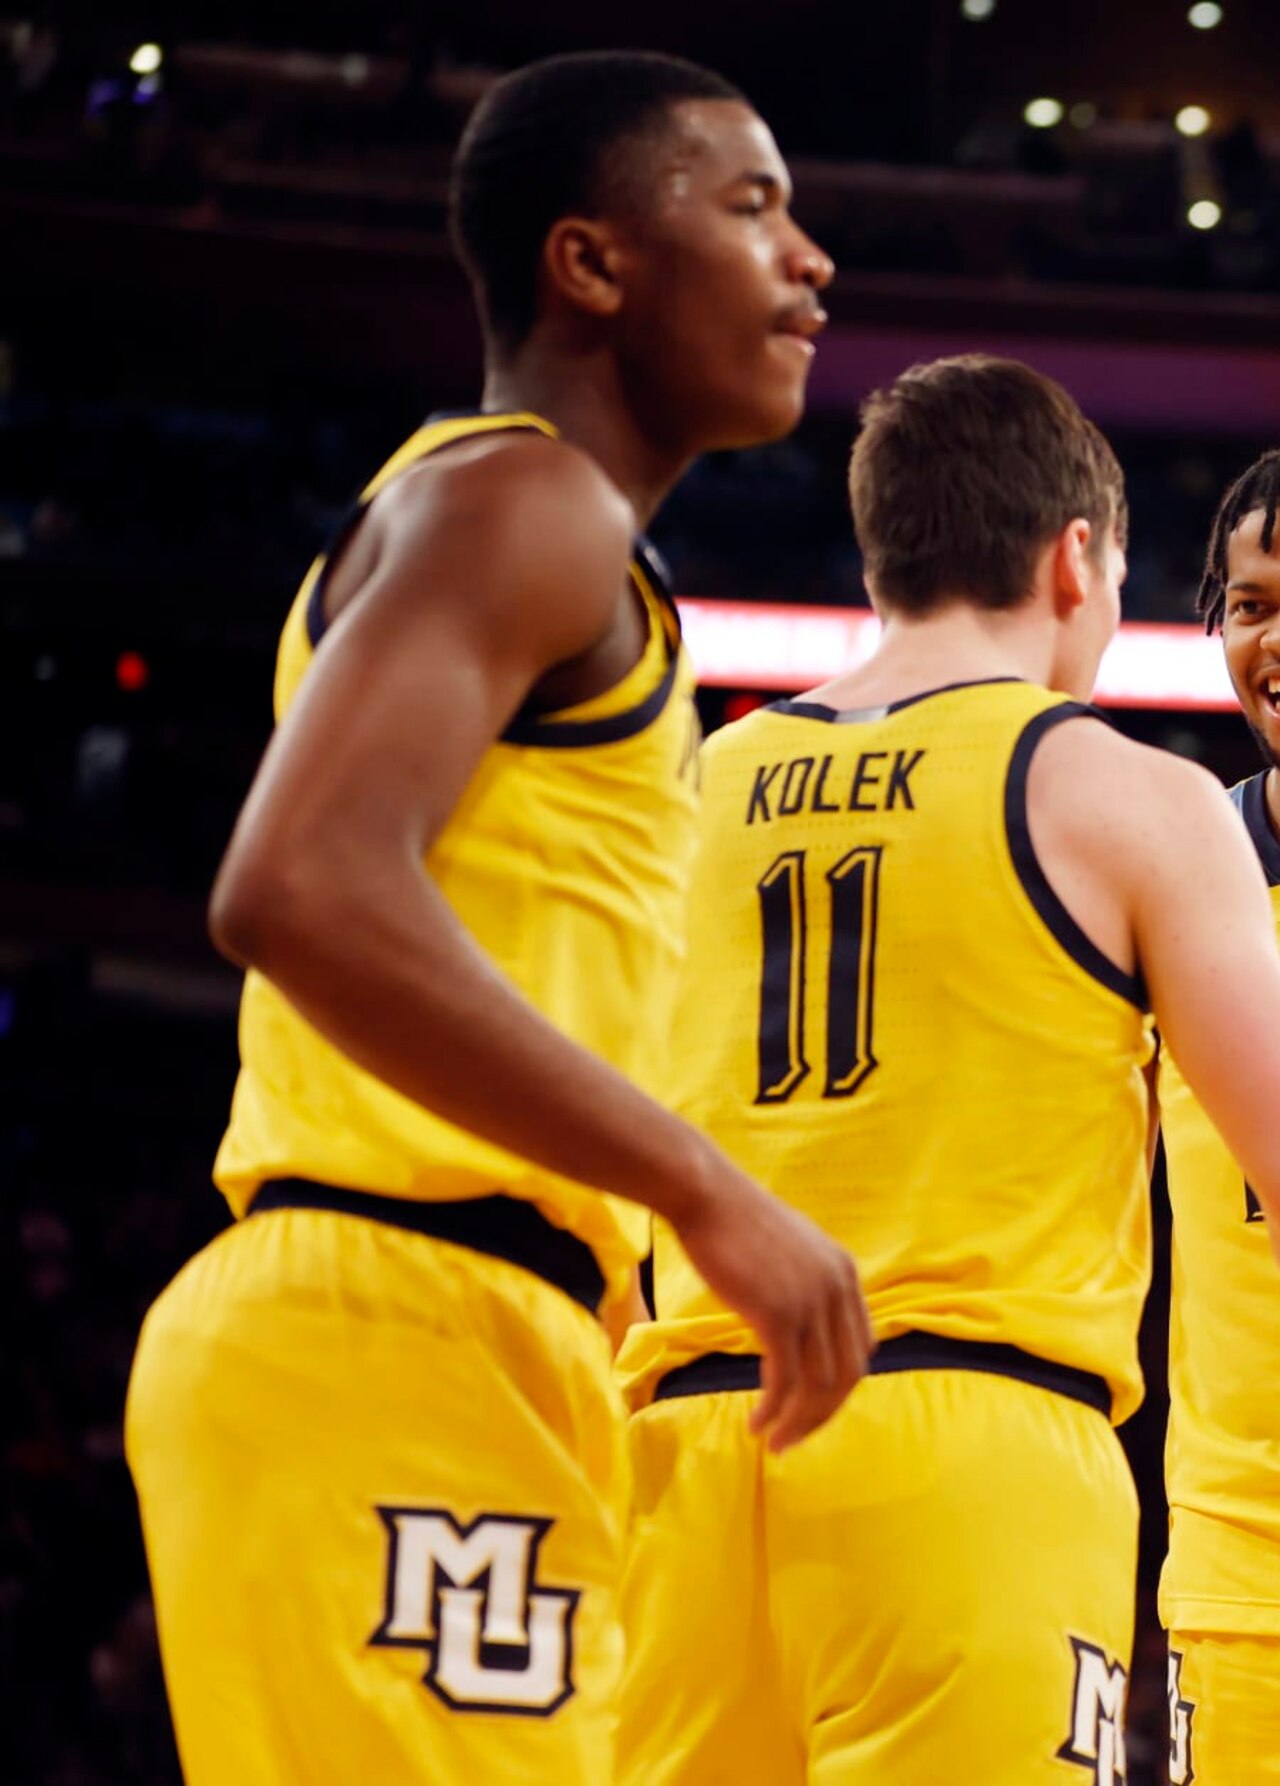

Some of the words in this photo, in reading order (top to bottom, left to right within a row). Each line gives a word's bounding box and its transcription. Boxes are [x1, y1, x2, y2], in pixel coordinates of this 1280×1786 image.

[746, 750, 926, 825] KOLEK
[753, 845, 884, 1105] 11
[367, 1506, 583, 1718] MU
